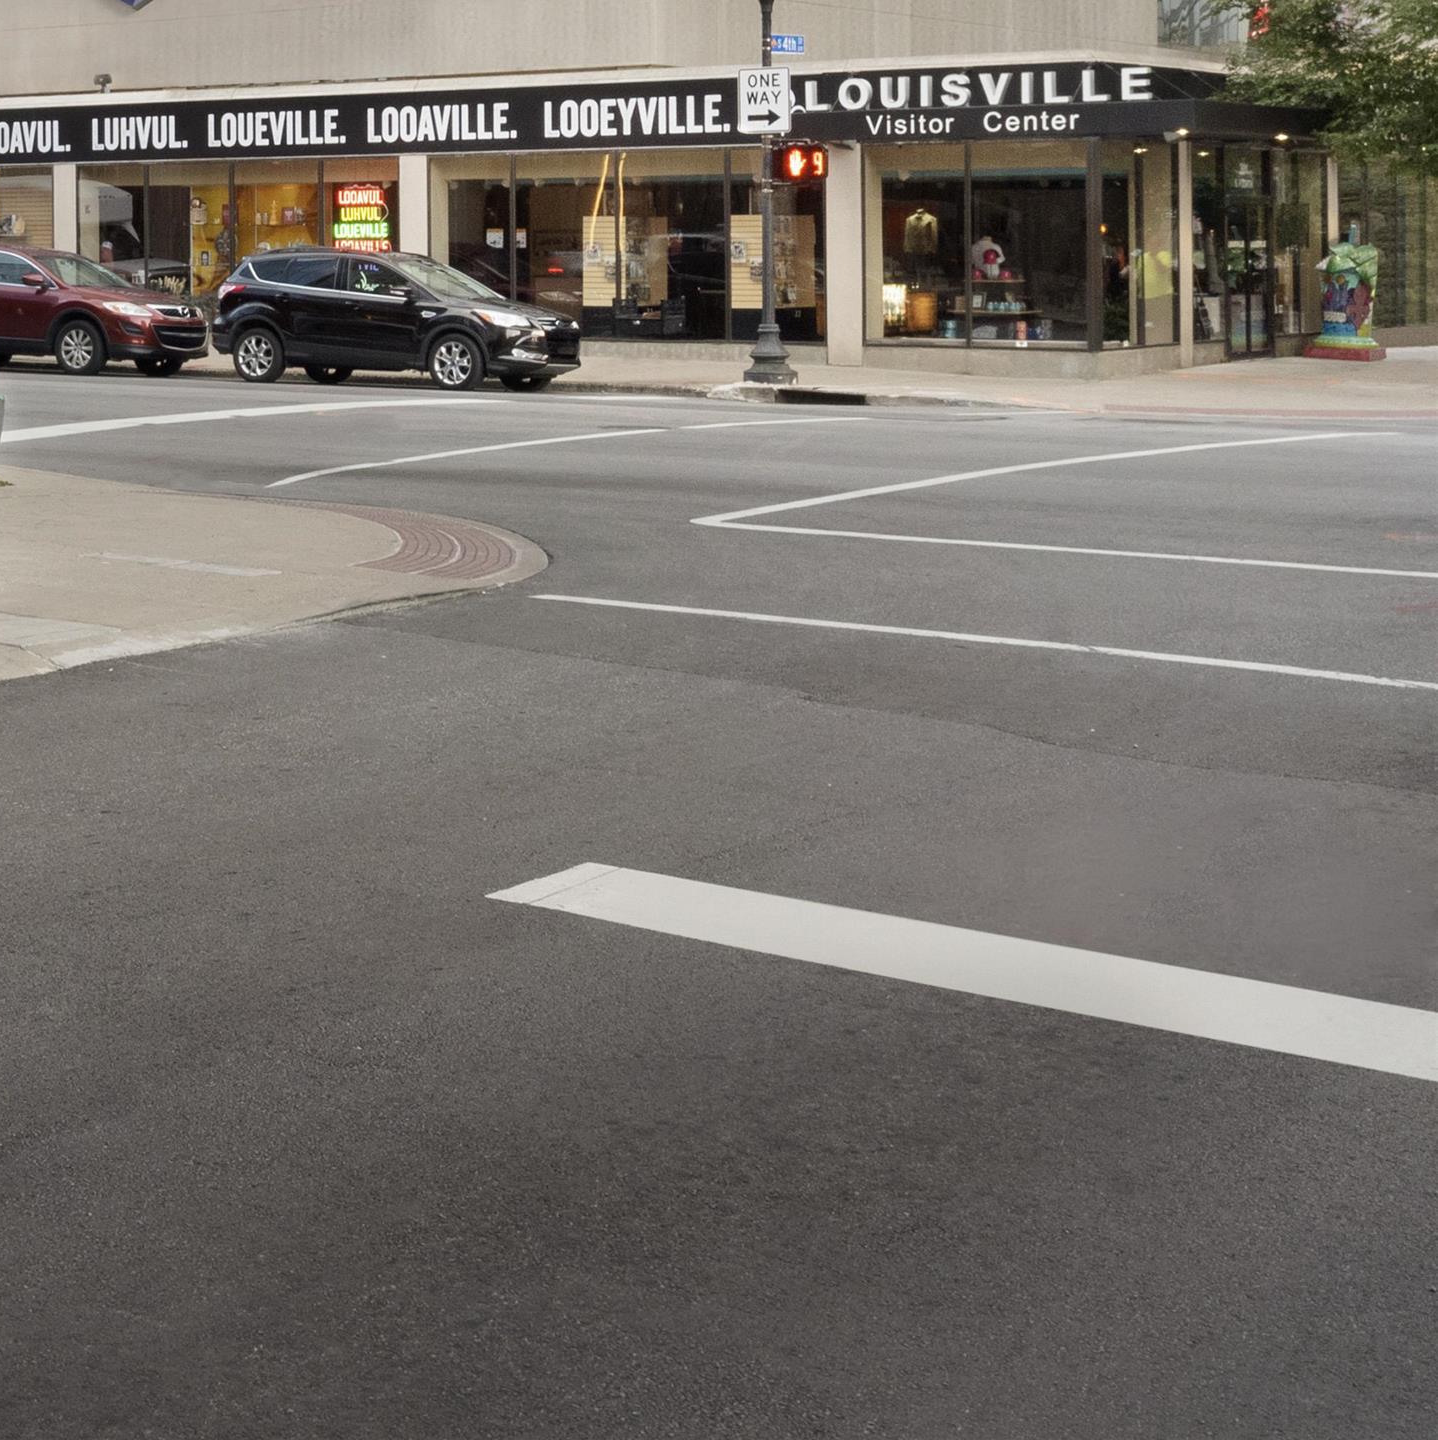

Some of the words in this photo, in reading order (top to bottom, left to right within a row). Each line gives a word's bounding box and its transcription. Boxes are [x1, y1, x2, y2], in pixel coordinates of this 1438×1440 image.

[747, 73, 781, 88] ONE
[746, 90, 782, 105] WAY
[804, 67, 1153, 113] LOUISVILLE
[91, 115, 188, 151] LUHVUL.
[207, 108, 346, 147] LOUEVILLE.
[366, 101, 518, 144] LOOAVILLE.
[543, 94, 731, 139] LOOEYVILLE.
[865, 114, 955, 136] Visitor
[983, 112, 1080, 134] Center
[338, 190, 384, 205] LOOAVUL
[334, 222, 389, 239] LOUEVILLE
